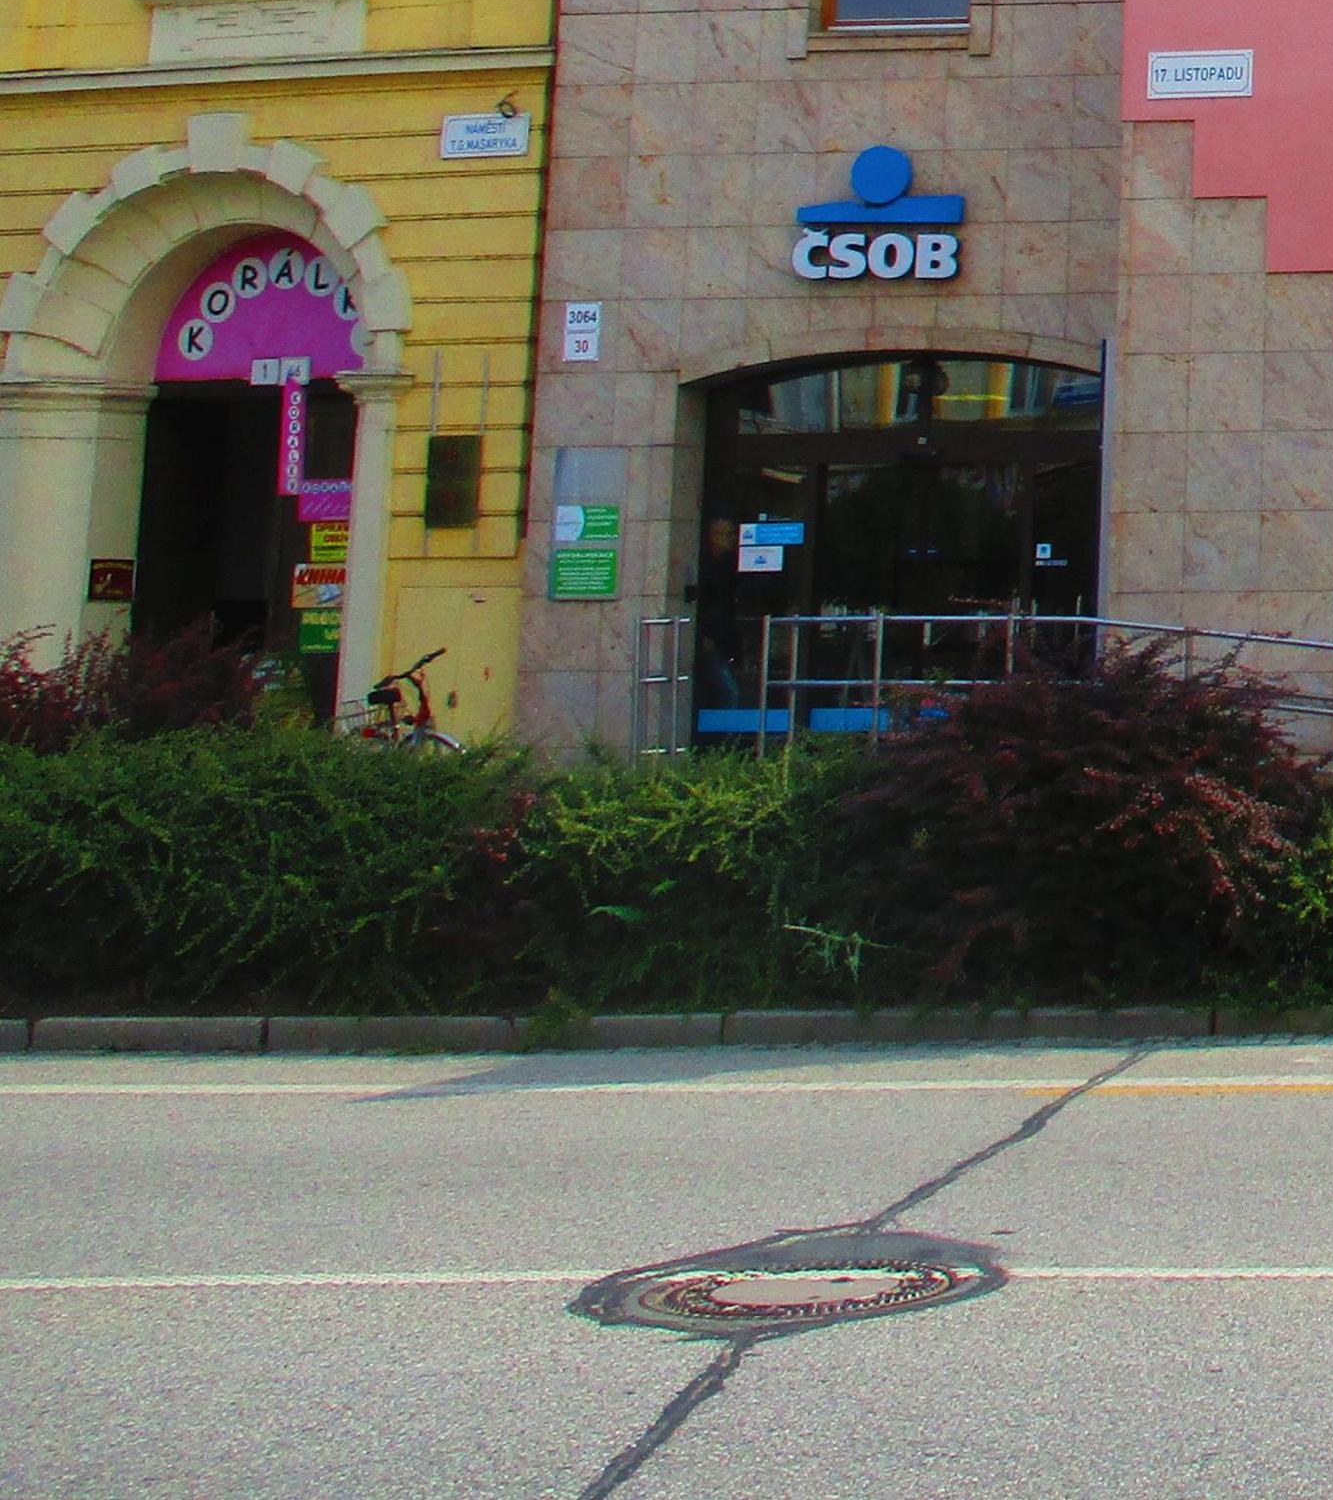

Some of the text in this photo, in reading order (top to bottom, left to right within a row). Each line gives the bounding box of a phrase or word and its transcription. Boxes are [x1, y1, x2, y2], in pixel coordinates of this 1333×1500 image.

[1173, 65, 1244, 82] LISTOPADU
[791, 227, 959, 280] ČSOB
[186, 249, 358, 355] KORÁLK
[568, 310, 598, 325] 3064
